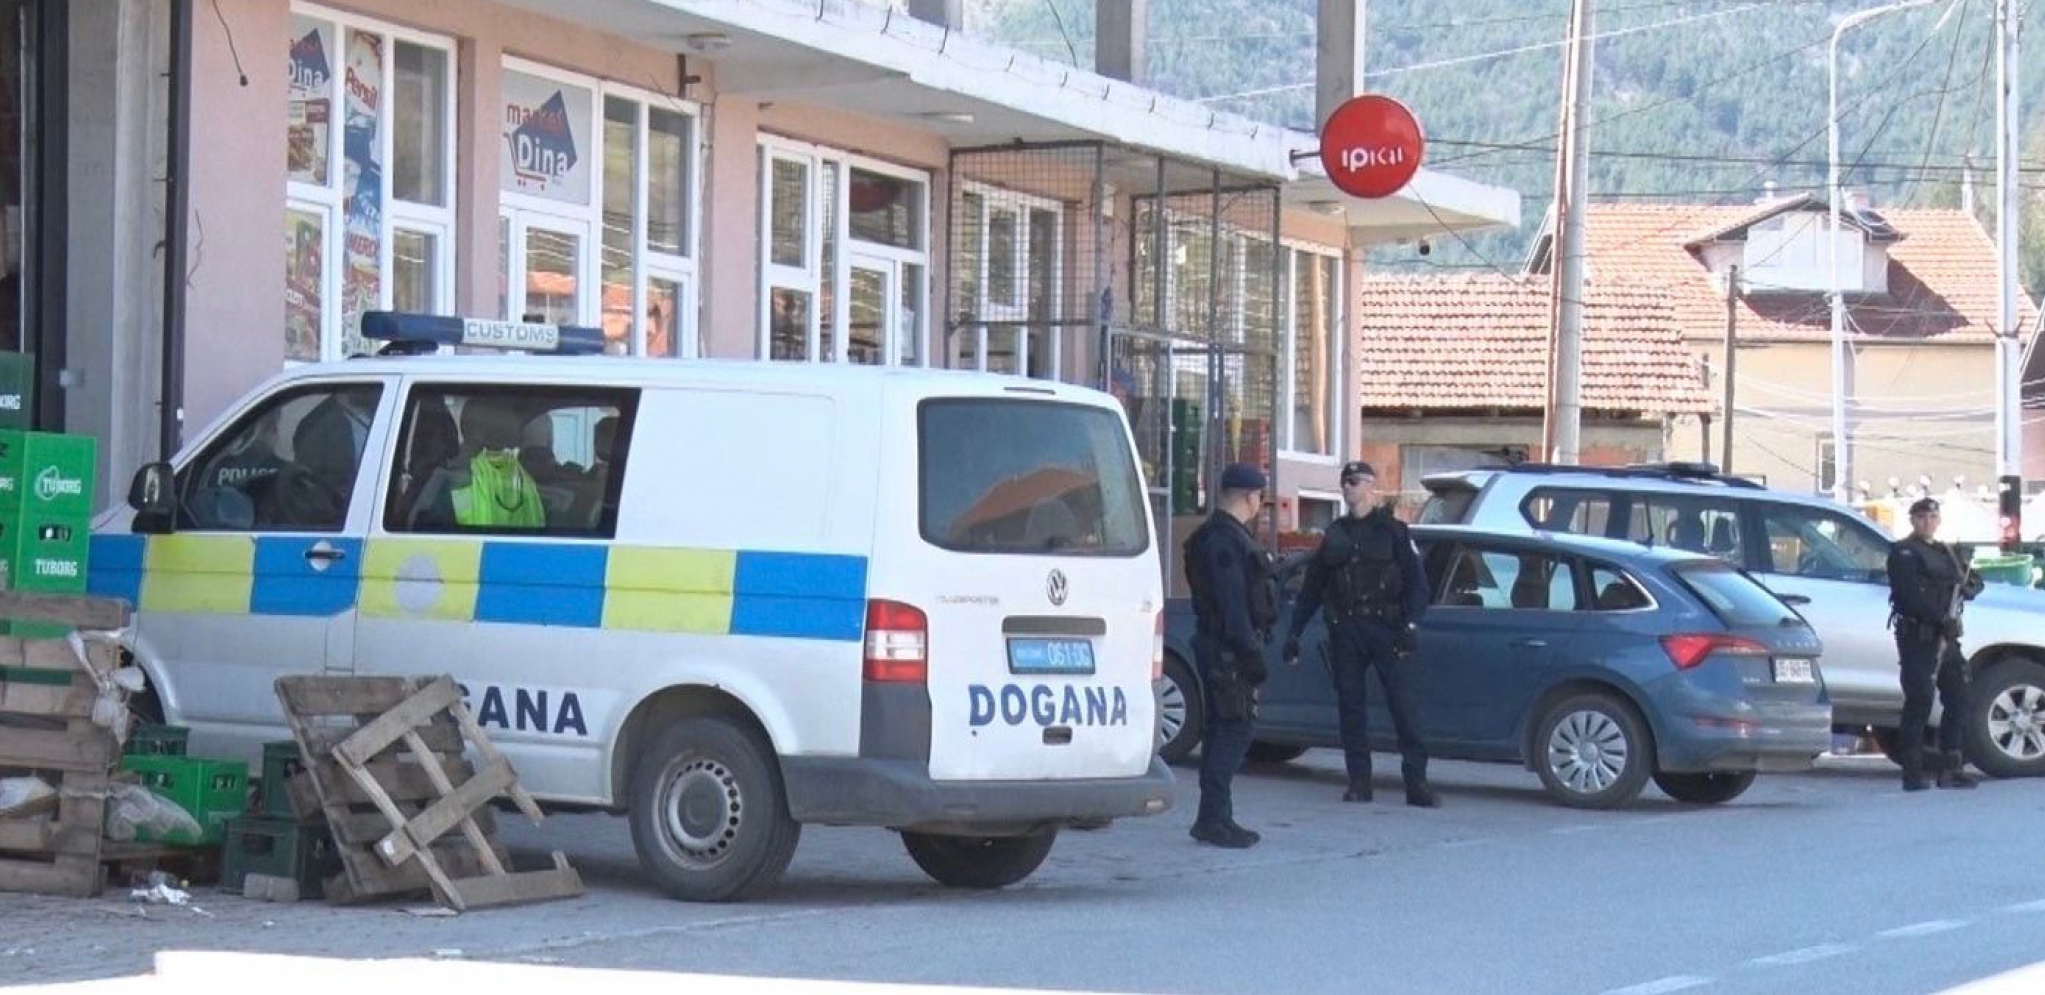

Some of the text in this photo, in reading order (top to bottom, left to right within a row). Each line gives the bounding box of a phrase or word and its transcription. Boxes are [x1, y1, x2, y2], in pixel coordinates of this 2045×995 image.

[345, 66, 378, 110] Persil
[517, 133, 568, 178] Dina
[466, 322, 556, 344] CUSTOMS
[43, 477, 81, 494] TUBORG
[35, 558, 78, 577] TUBORG
[457, 683, 588, 736] ANA
[968, 684, 1127, 727] DOGANA
